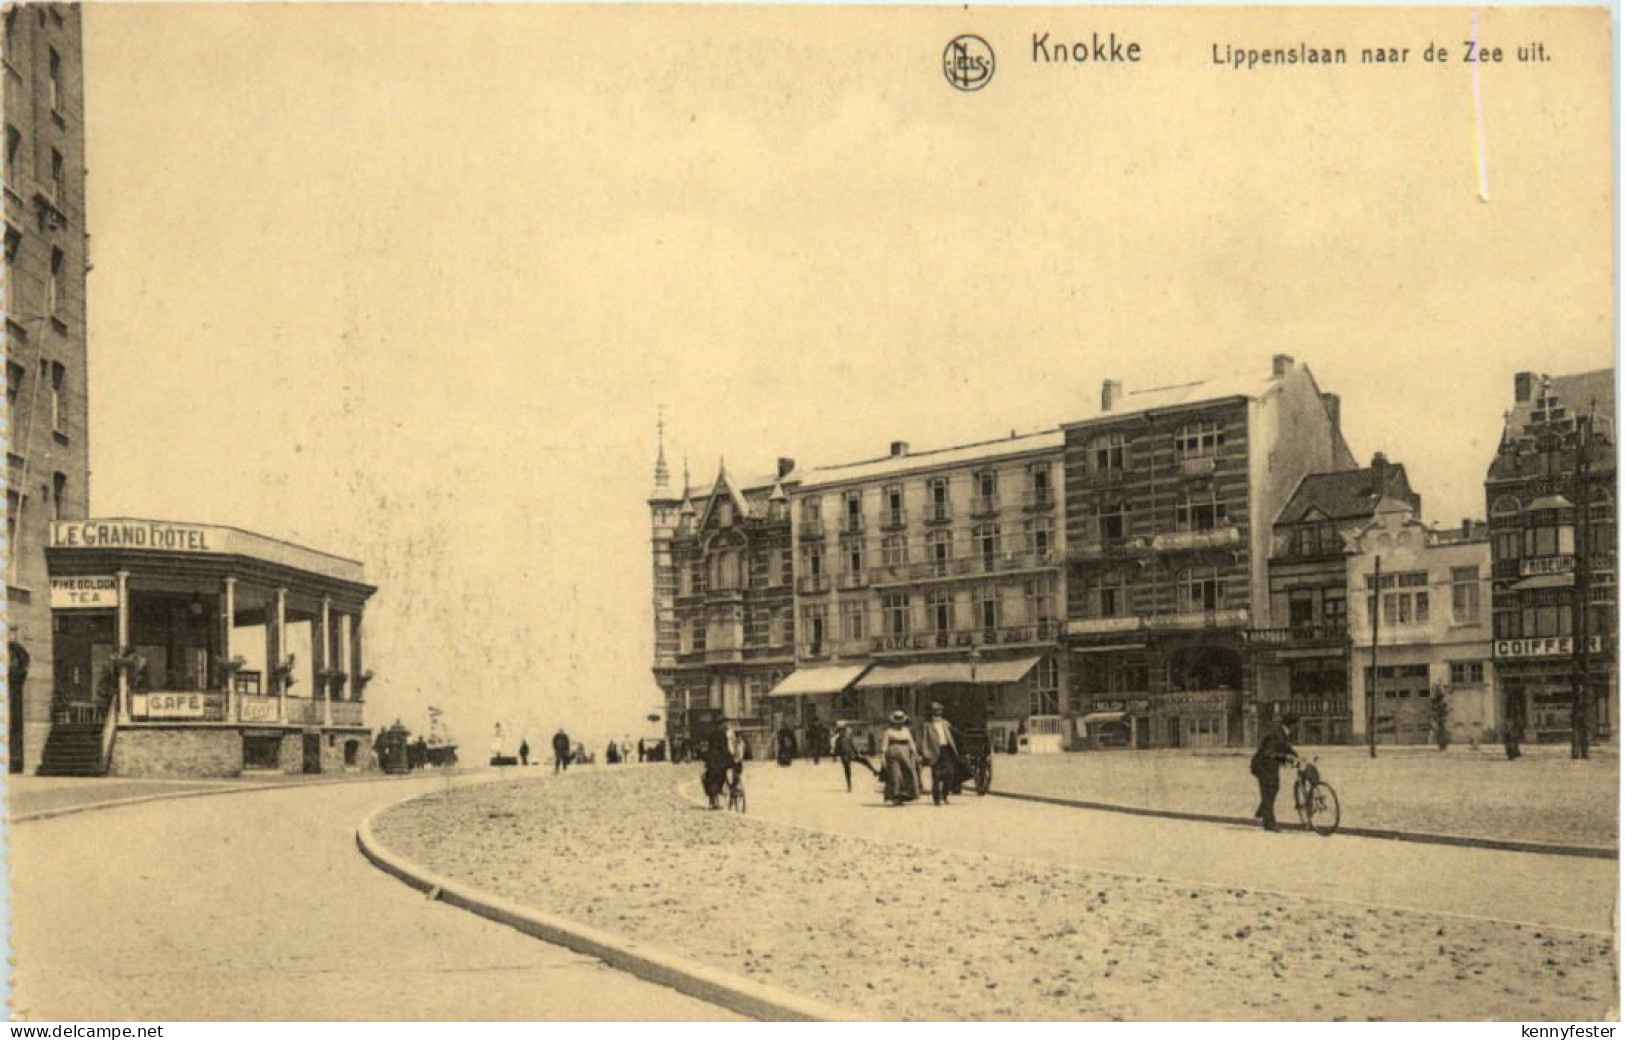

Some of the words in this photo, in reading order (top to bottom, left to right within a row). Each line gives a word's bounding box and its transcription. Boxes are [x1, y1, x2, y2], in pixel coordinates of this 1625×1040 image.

[1032, 32, 1142, 62] Knokke
[1212, 43, 1346, 69] Lippenslaan
[1361, 46, 1409, 63] naar
[1423, 43, 1448, 62] de
[1463, 41, 1502, 62] Zee
[1517, 42, 1551, 62] uit.
[82, 522, 146, 546] GRAND
[69, 592, 100, 603] TEA
[1498, 637, 1598, 656] COIFFER
